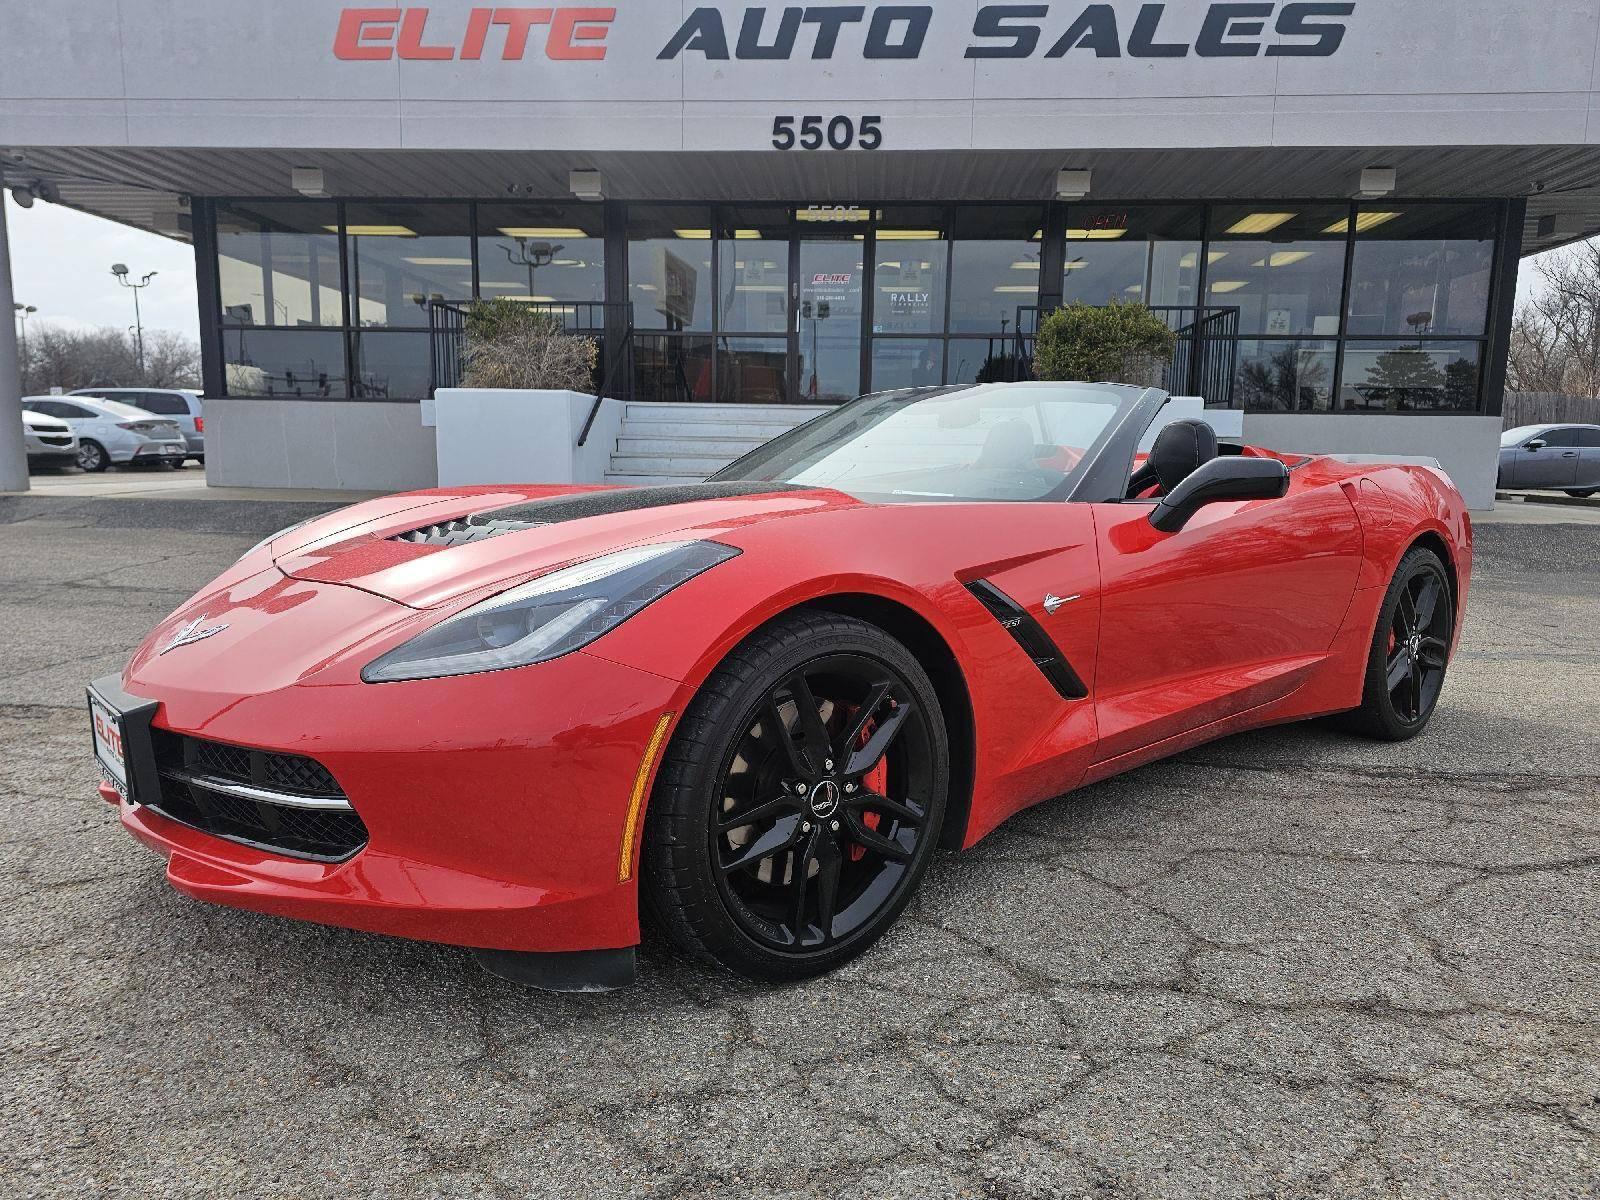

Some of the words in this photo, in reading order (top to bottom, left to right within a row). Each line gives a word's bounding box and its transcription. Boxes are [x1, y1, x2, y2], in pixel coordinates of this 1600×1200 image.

[333, 8, 616, 60] ELITE
[656, 6, 933, 60] AUTO
[964, 2, 1356, 58] SALES
[772, 115, 882, 150] 5505
[808, 205, 860, 223] 5505
[1082, 213, 1127, 229] OPEN
[814, 273, 851, 283] ELITE
[891, 293, 929, 304] RALLY
